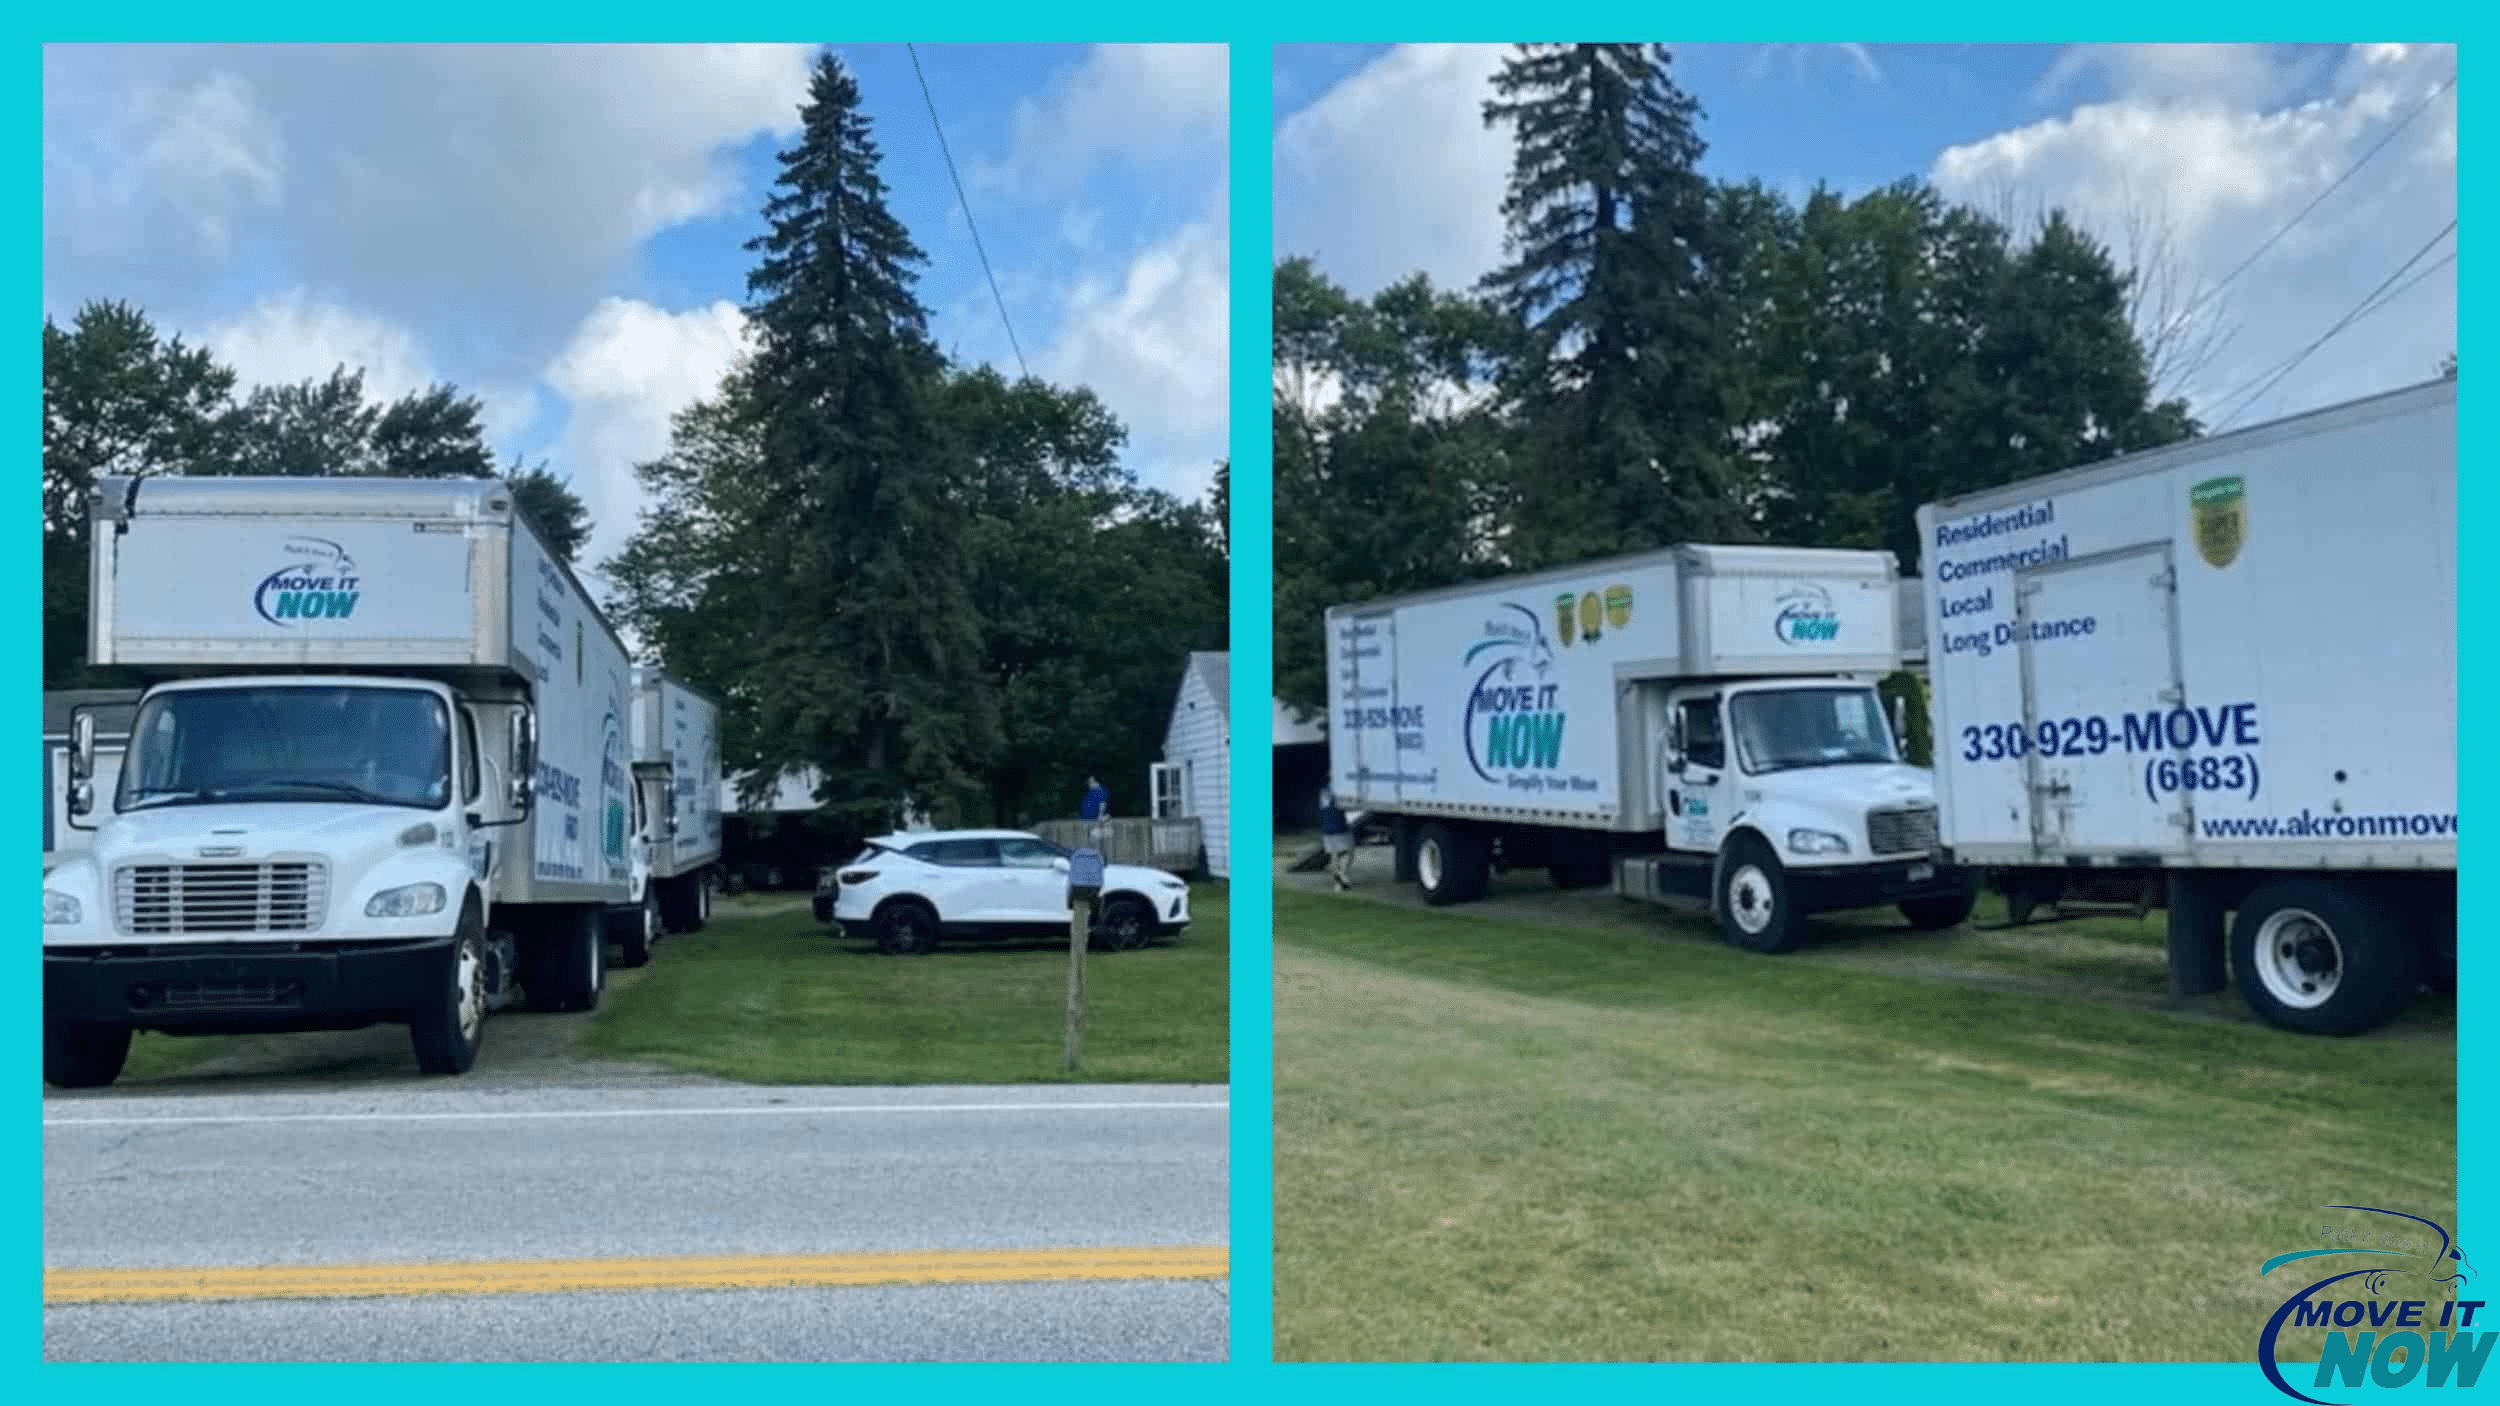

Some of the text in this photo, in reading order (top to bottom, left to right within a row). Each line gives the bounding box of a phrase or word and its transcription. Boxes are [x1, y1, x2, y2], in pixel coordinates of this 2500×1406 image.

[1936, 499, 2054, 547] Residential
[1938, 533, 2068, 582] Commercial
[271, 576, 359, 590] MOVE IT
[1940, 586, 1994, 618] Local
[275, 591, 360, 618] NOW
[1791, 620, 1840, 640] NOW
[1942, 616, 2097, 657] Long Ditance
[1477, 683, 1559, 712] MOVE IT
[1486, 712, 1566, 768] NOW
[1962, 702, 2260, 762] 330-929-MOVE
[2145, 752, 2260, 804] (6683)
